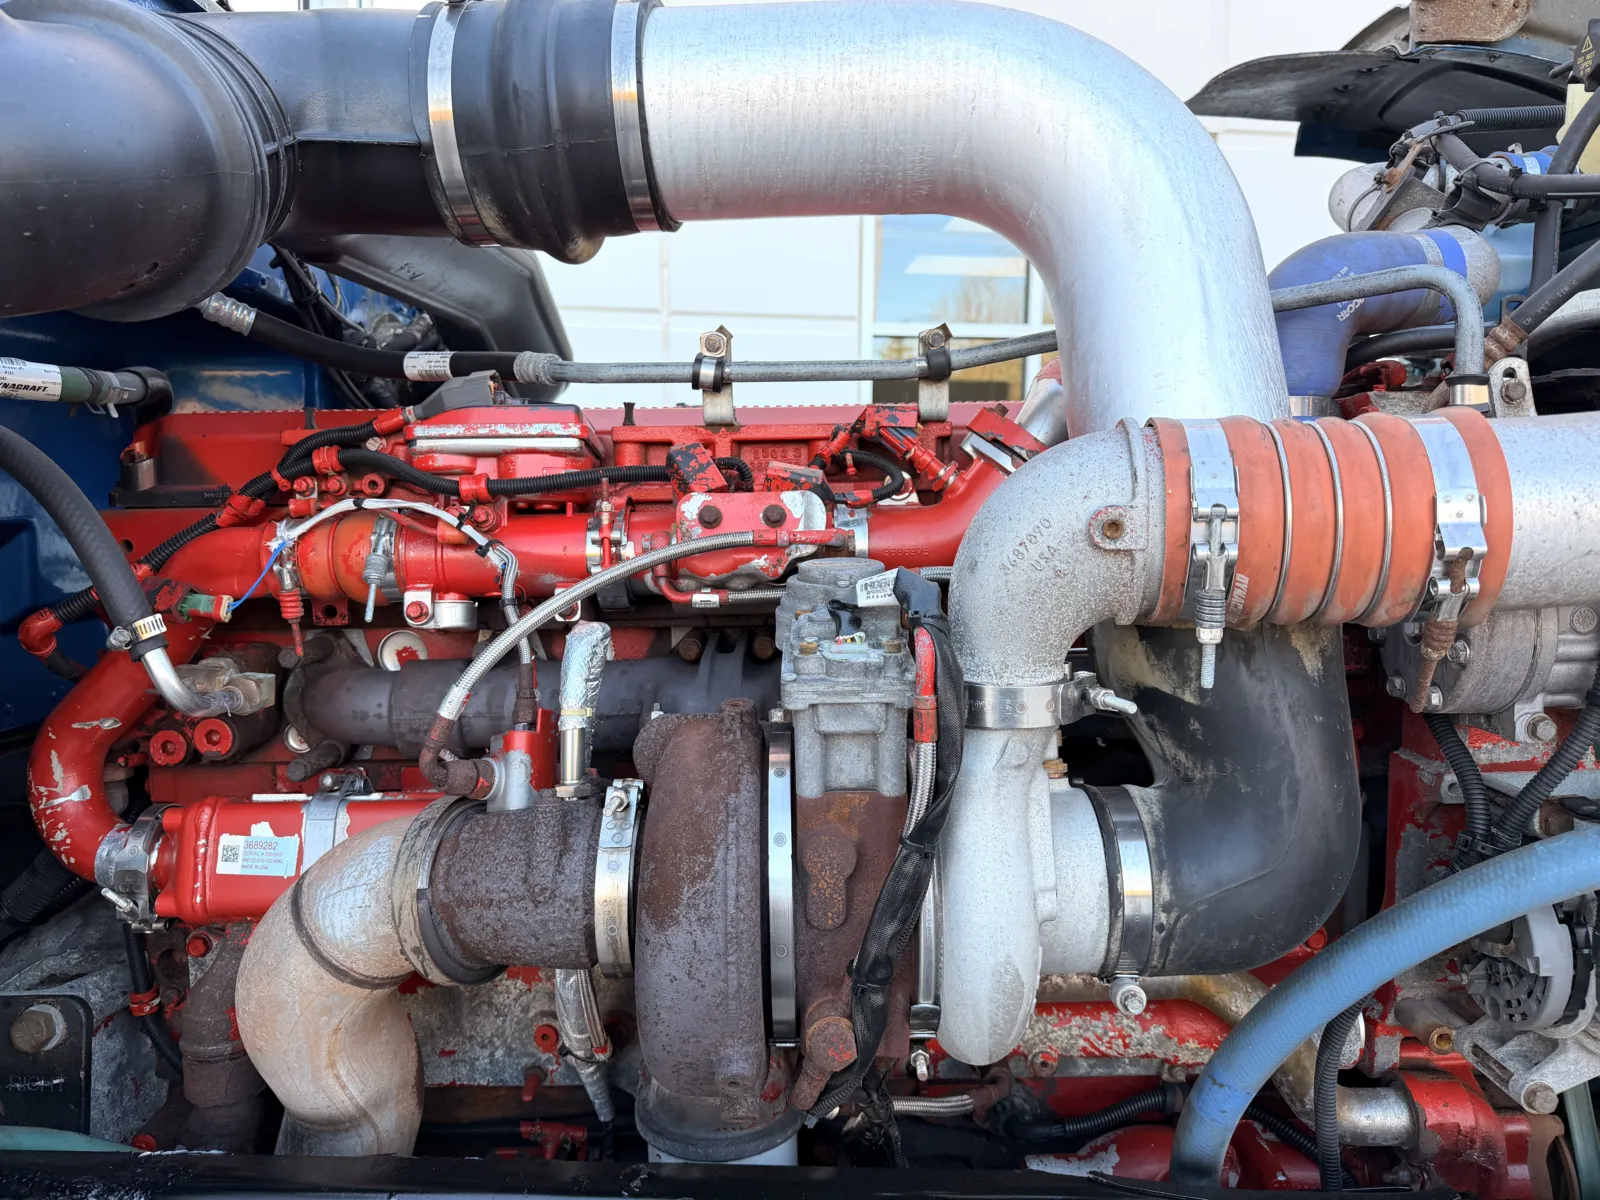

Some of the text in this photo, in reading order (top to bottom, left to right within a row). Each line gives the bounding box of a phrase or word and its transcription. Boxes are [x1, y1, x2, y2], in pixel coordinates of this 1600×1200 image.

[1586, 50, 1596, 60] NOT
[1536, 301, 1551, 313] PET
[1030, 545, 1060, 572] USA
[243, 840, 279, 850] 3689282
[8, 1074, 67, 1092] RIGHT
